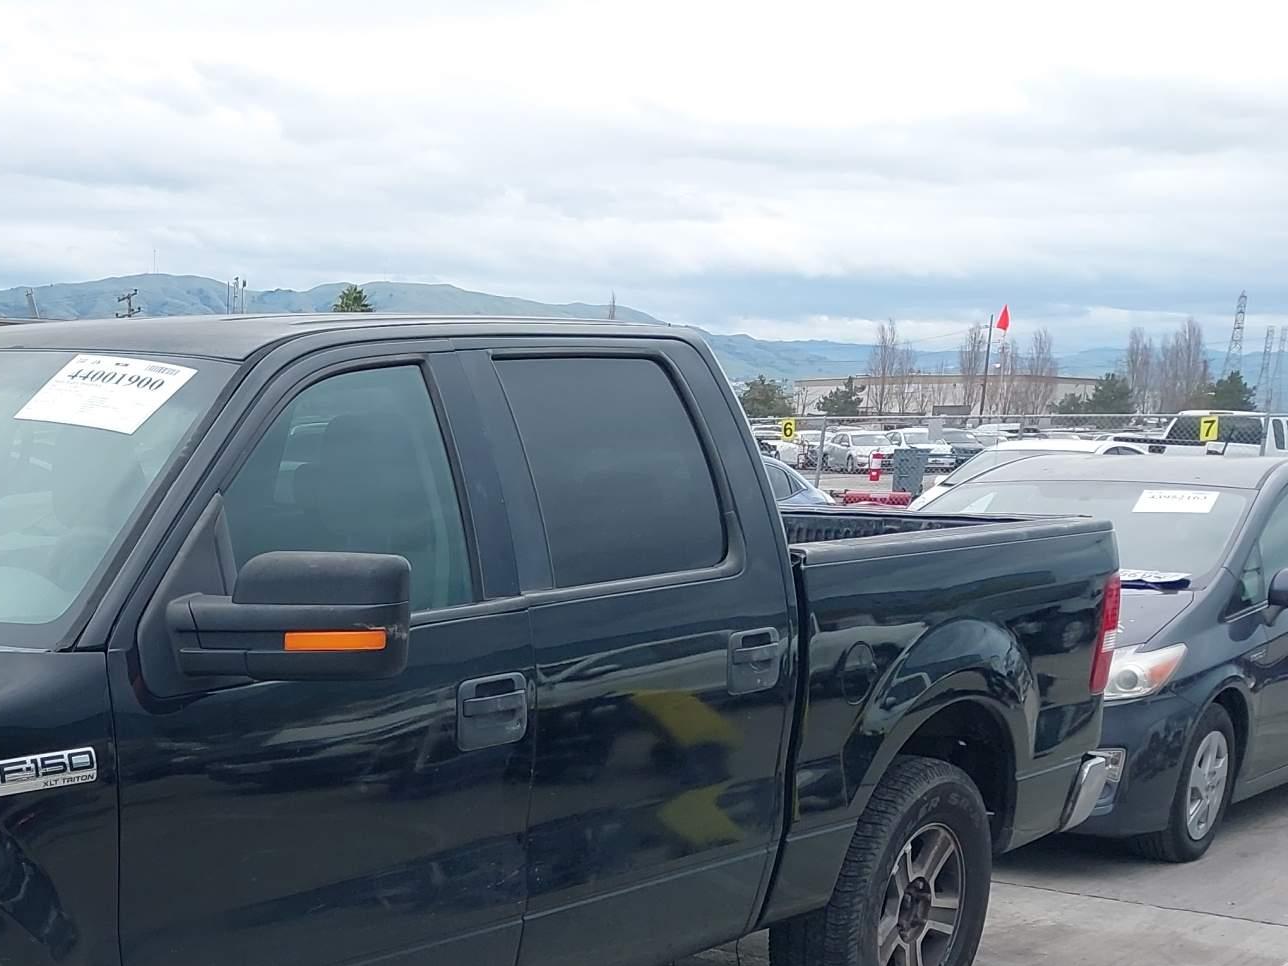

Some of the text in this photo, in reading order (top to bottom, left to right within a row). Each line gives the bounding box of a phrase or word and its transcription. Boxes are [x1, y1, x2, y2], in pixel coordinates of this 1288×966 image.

[67, 368, 165, 391] 44001900
[783, 421, 793, 438] 6
[1203, 419, 1216, 437] 7
[0, 750, 95, 784] F-150
[42, 773, 95, 787] XLT TRITON
